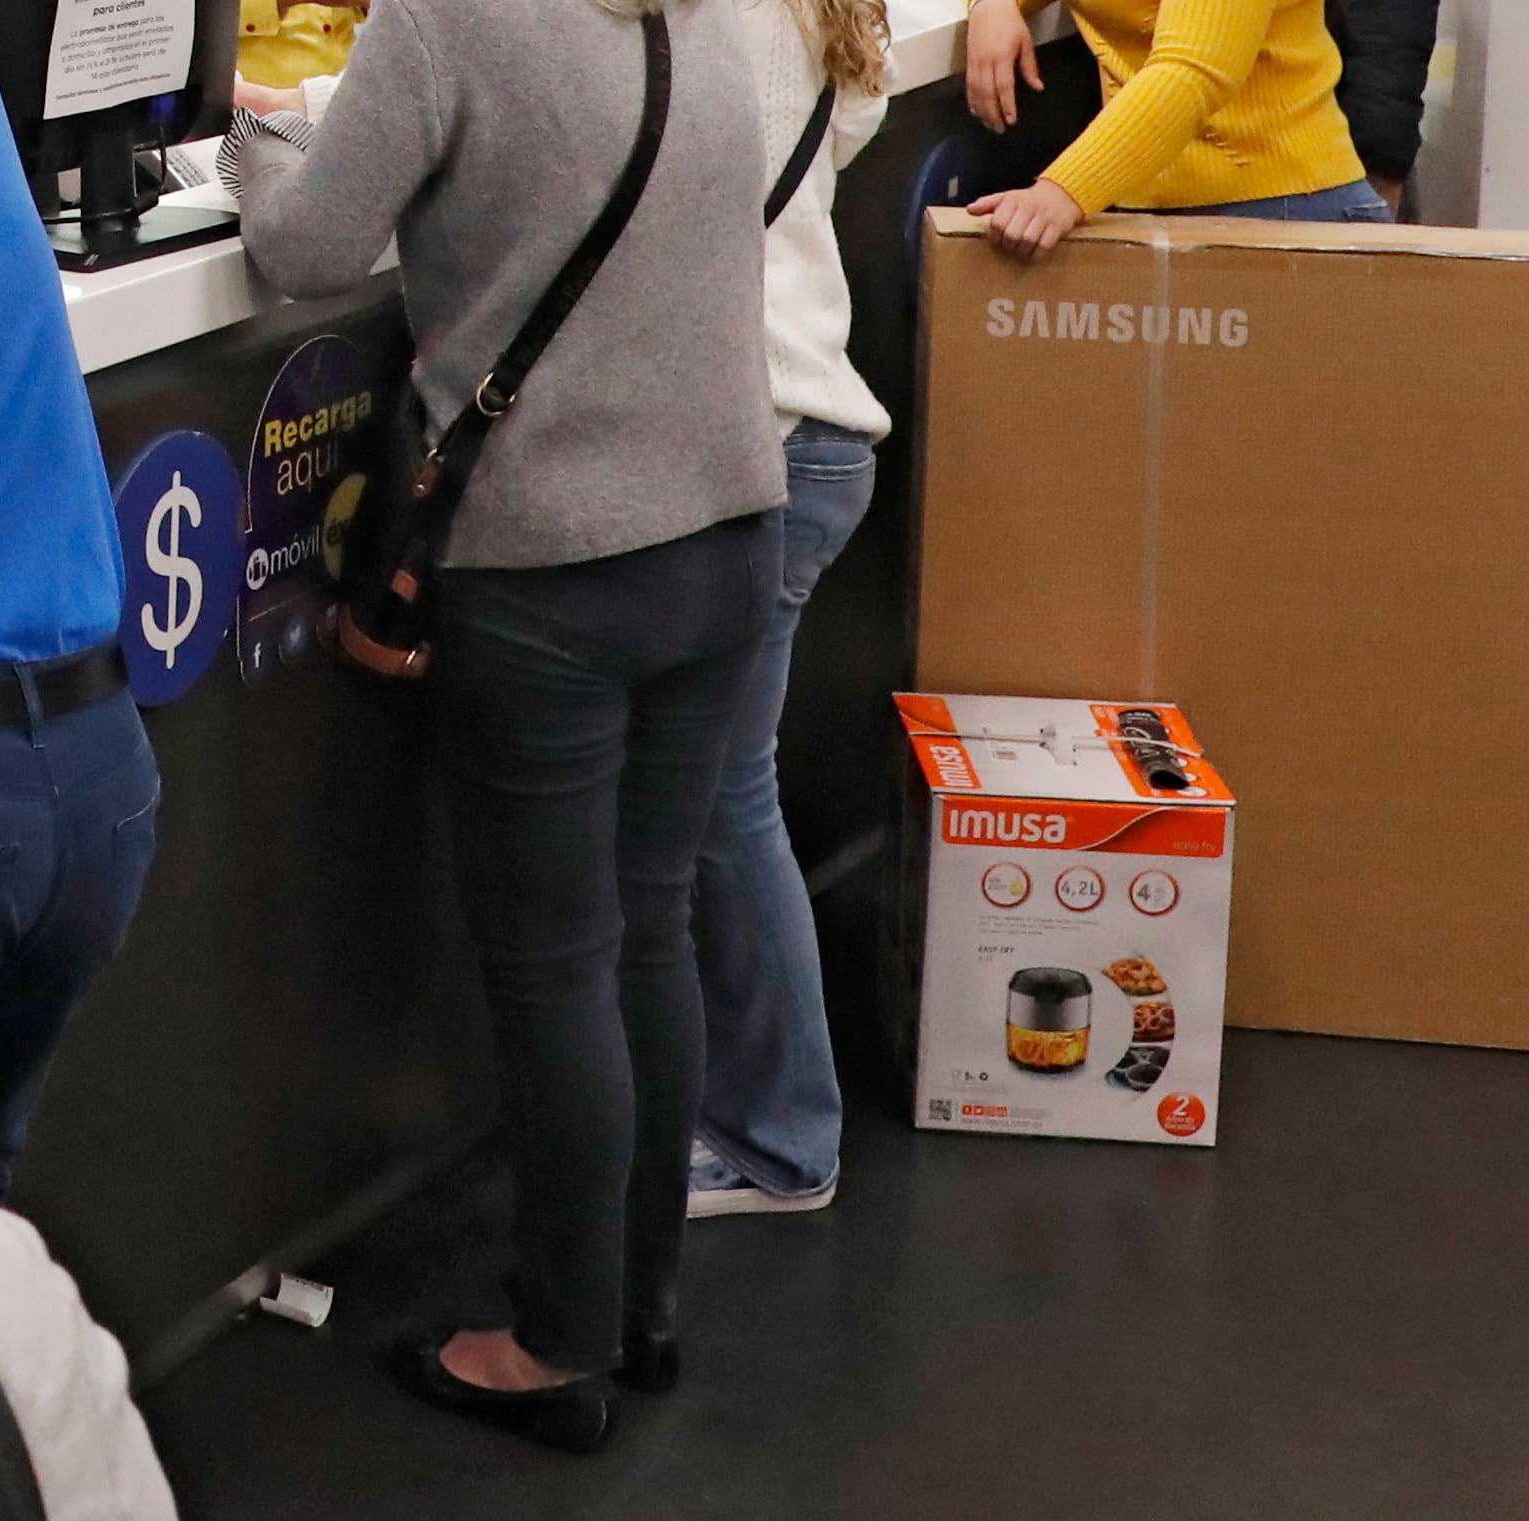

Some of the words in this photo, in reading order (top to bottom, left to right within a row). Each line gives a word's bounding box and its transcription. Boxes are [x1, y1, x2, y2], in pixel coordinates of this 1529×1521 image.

[92, 4, 114, 17] para
[987, 296, 1250, 348] SAMSUNG
[263, 391, 372, 458] Recarga
[269, 528, 320, 576] móvil
[1172, 1096, 1190, 1116] 2
